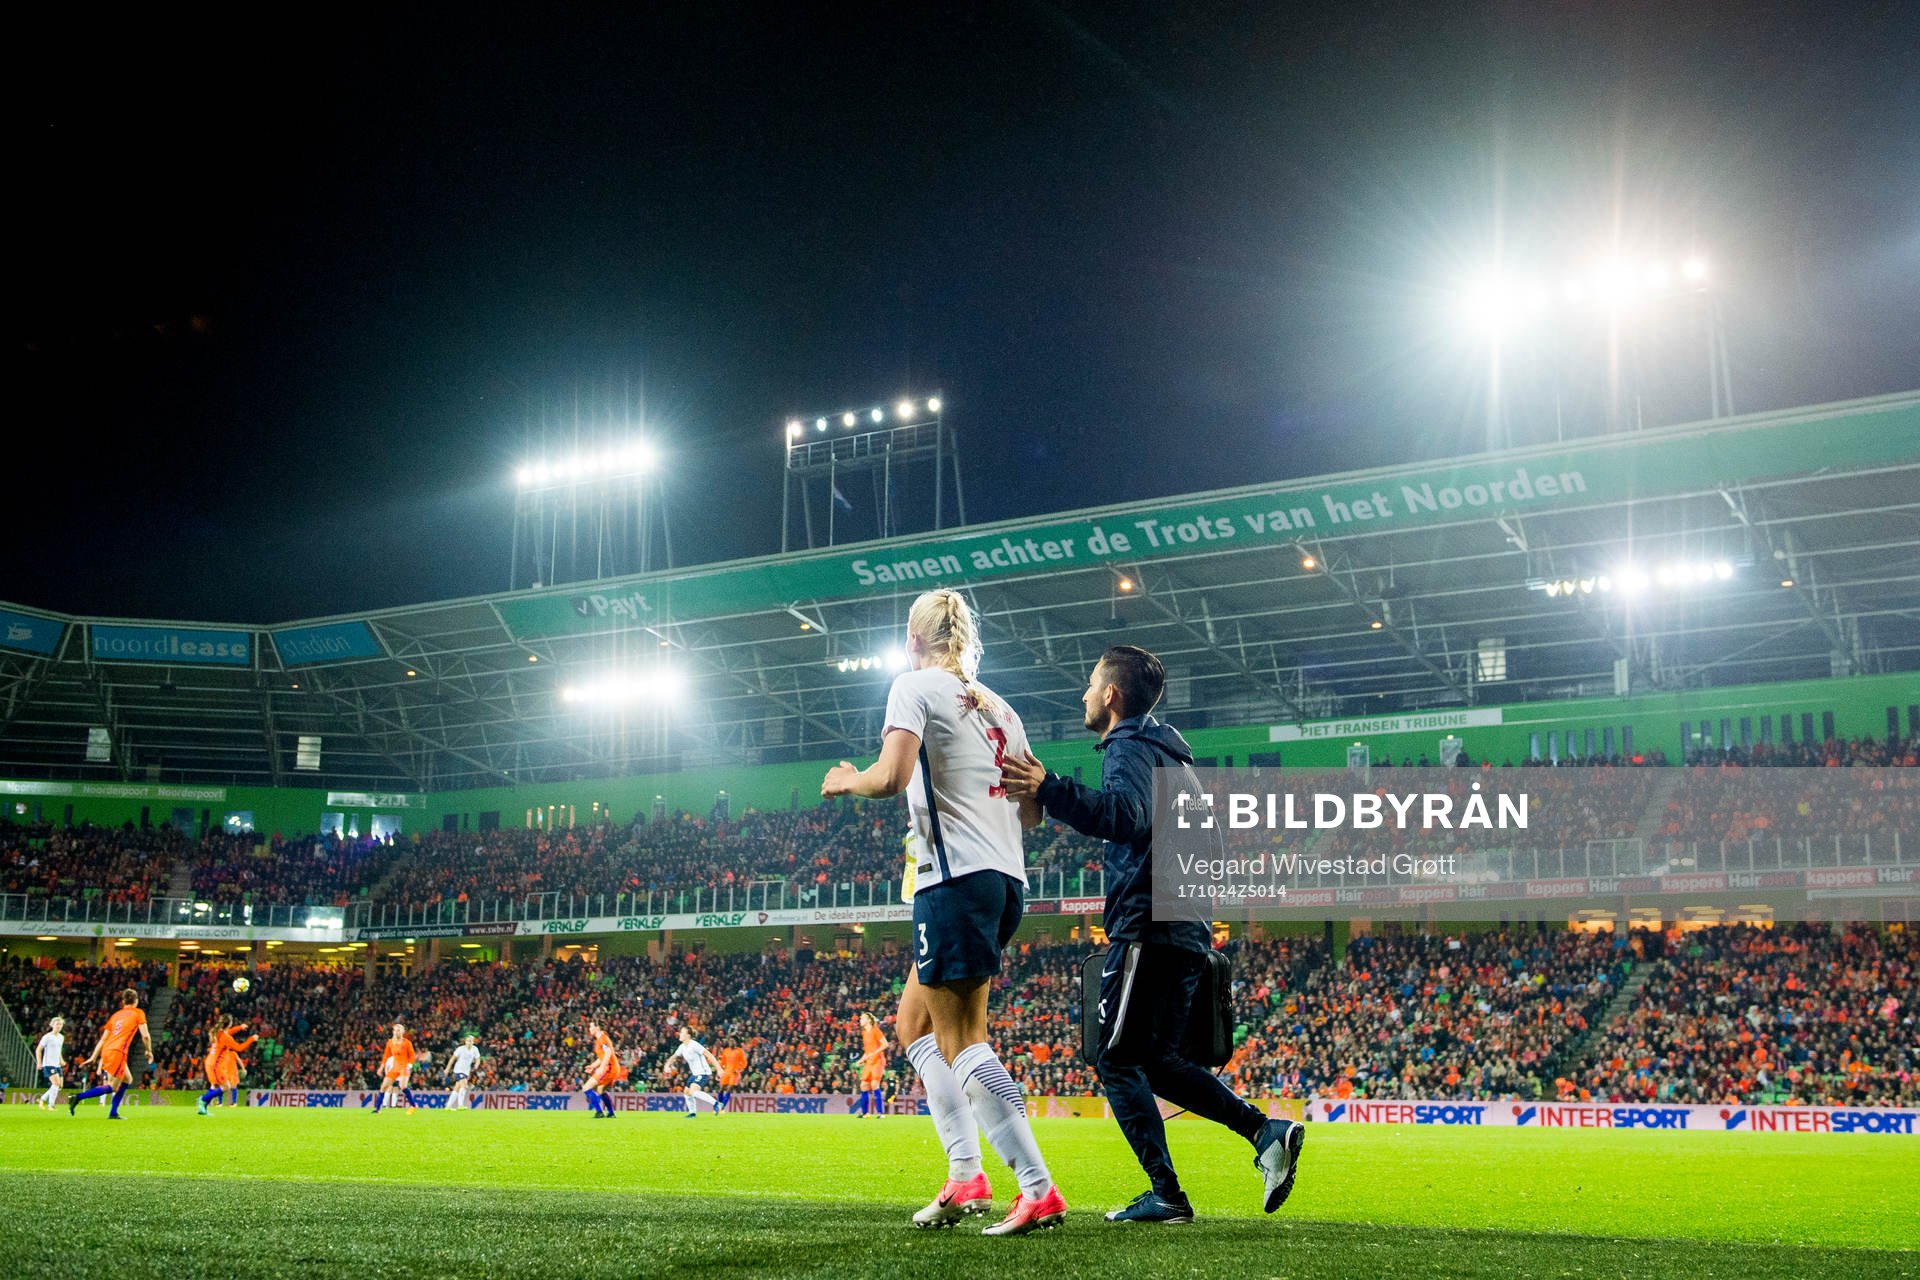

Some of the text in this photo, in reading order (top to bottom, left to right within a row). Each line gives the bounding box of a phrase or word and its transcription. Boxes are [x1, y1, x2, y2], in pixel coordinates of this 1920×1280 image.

[852, 468, 1587, 586] Samen achter de Trots van het Noorden
[590, 592, 653, 619] Payt
[95, 635, 247, 657] noordlease
[1300, 714, 1468, 738] PIET FRANSEN TRIBUNE
[158, 787, 223, 799] Noorderpoort
[1400, 887, 1454, 901] kappers
[1526, 881, 1584, 896] kappers
[1662, 876, 1724, 892] kappers
[1807, 871, 1873, 888] kappers
[814, 911, 826, 920] De
[829, 910, 854, 920] ideale
[856, 908, 885, 922] payroll
[888, 907, 912, 919] partn
[1061, 900, 1105, 914] kappers
[542, 920, 590, 933] VERKLEY
[617, 917, 666, 930] VERKLEY
[695, 912, 747, 927] VERKLEY
[918, 922, 929, 956] 3
[270, 1093, 346, 1108] INTERSPORT
[484, 1094, 571, 1110] INTERSPORT
[728, 1097, 828, 1114] INTERSPORT
[1350, 1104, 1485, 1126] INTERSPORT
[1540, 1106, 1691, 1130] INTERSPORT
[1751, 1109, 1918, 1135] INTERSPORT
